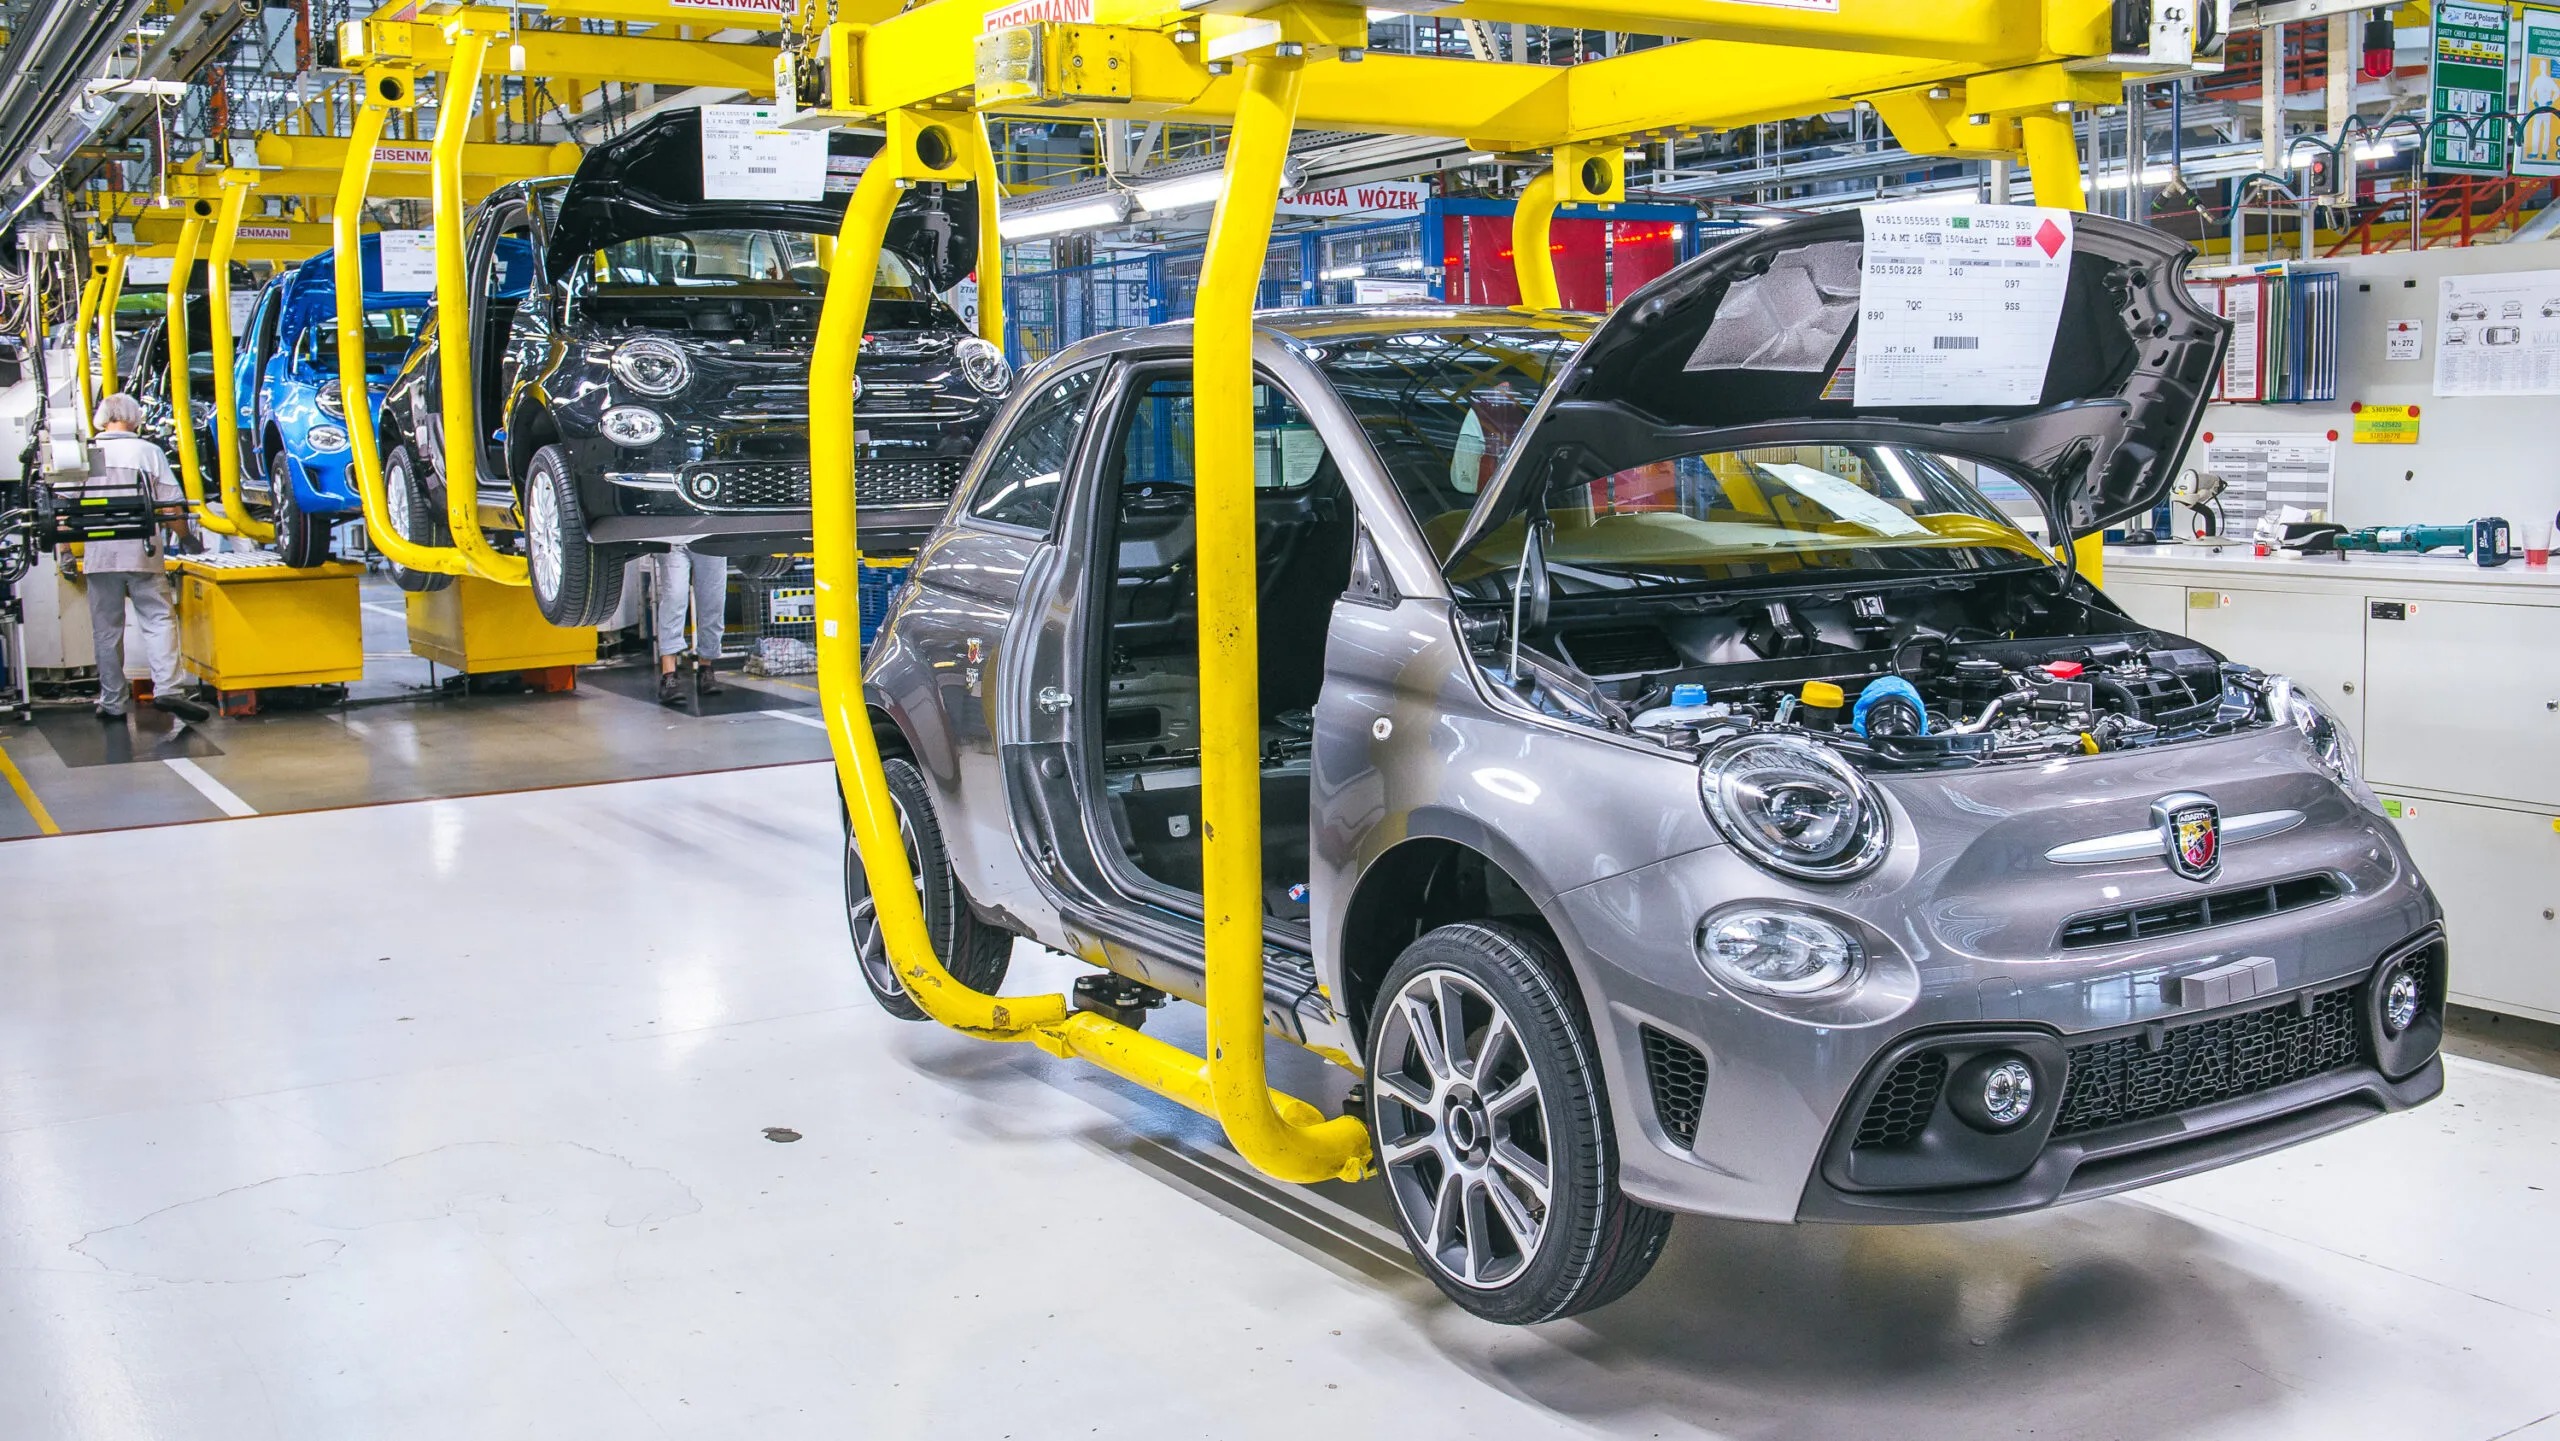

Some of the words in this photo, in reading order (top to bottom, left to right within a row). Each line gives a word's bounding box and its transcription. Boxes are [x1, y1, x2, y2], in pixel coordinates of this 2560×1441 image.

[2464, 12, 2476, 20] FCA
[2478, 13, 2498, 23] Poland
[1358, 186, 1418, 210] WÓZEK
[1869, 265, 1886, 274] 505
[1888, 265, 1905, 275] 508
[1906, 266, 1922, 275] 228
[1948, 267, 1964, 276] 140
[2004, 279, 2020, 289] 097
[1906, 300, 1922, 310] 7QC
[1867, 311, 1885, 320] 890
[1948, 312, 1964, 321] 195
[2223, 596, 2229, 604] A
[2410, 604, 2417, 613] B
[2409, 807, 2416, 816] A
[2180, 812, 2209, 822] ABARTH
